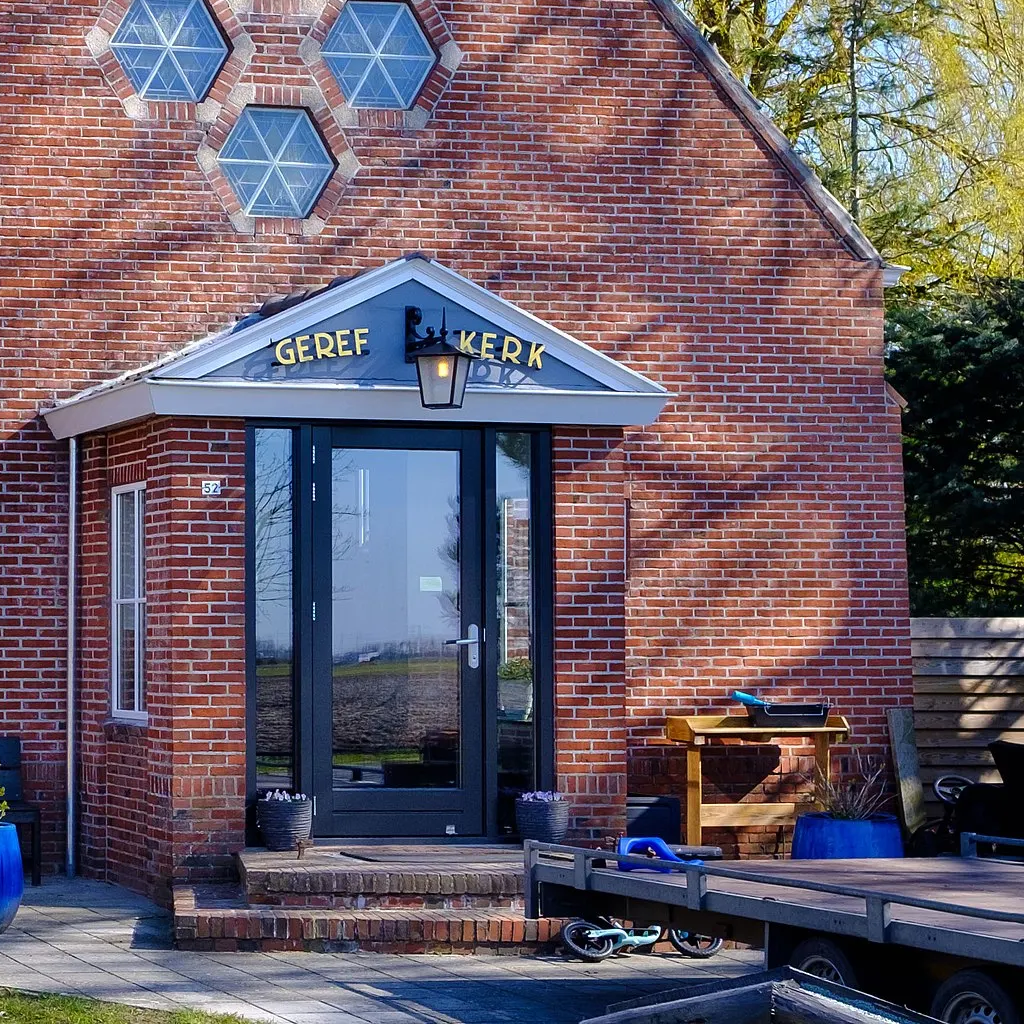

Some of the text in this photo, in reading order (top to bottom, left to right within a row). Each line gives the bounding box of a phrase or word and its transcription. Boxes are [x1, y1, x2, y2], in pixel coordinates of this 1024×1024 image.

[275, 328, 546, 369] GEREF KERK
[204, 482, 219, 494] 52
